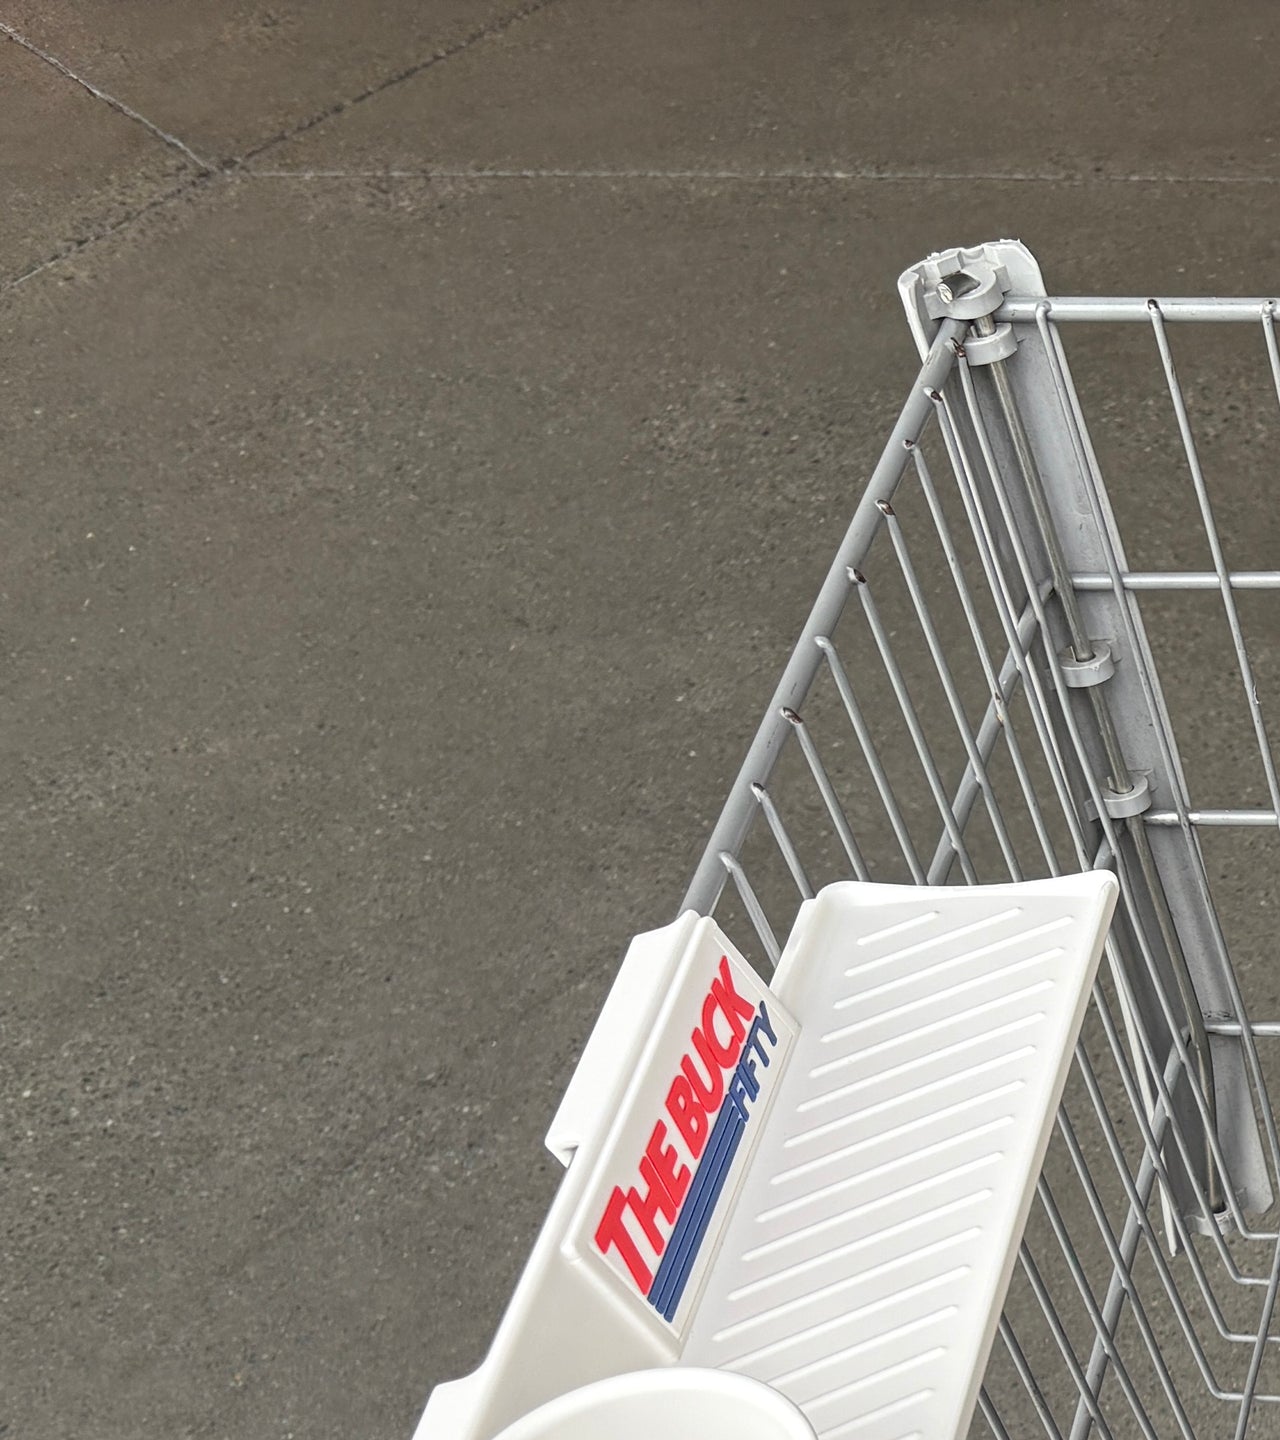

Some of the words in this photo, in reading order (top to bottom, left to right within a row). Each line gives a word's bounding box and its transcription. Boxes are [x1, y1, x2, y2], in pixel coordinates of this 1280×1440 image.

[595, 1118, 691, 1296] THE
[664, 955, 756, 1160] BUCK
[728, 1000, 778, 1123] FIFTY
